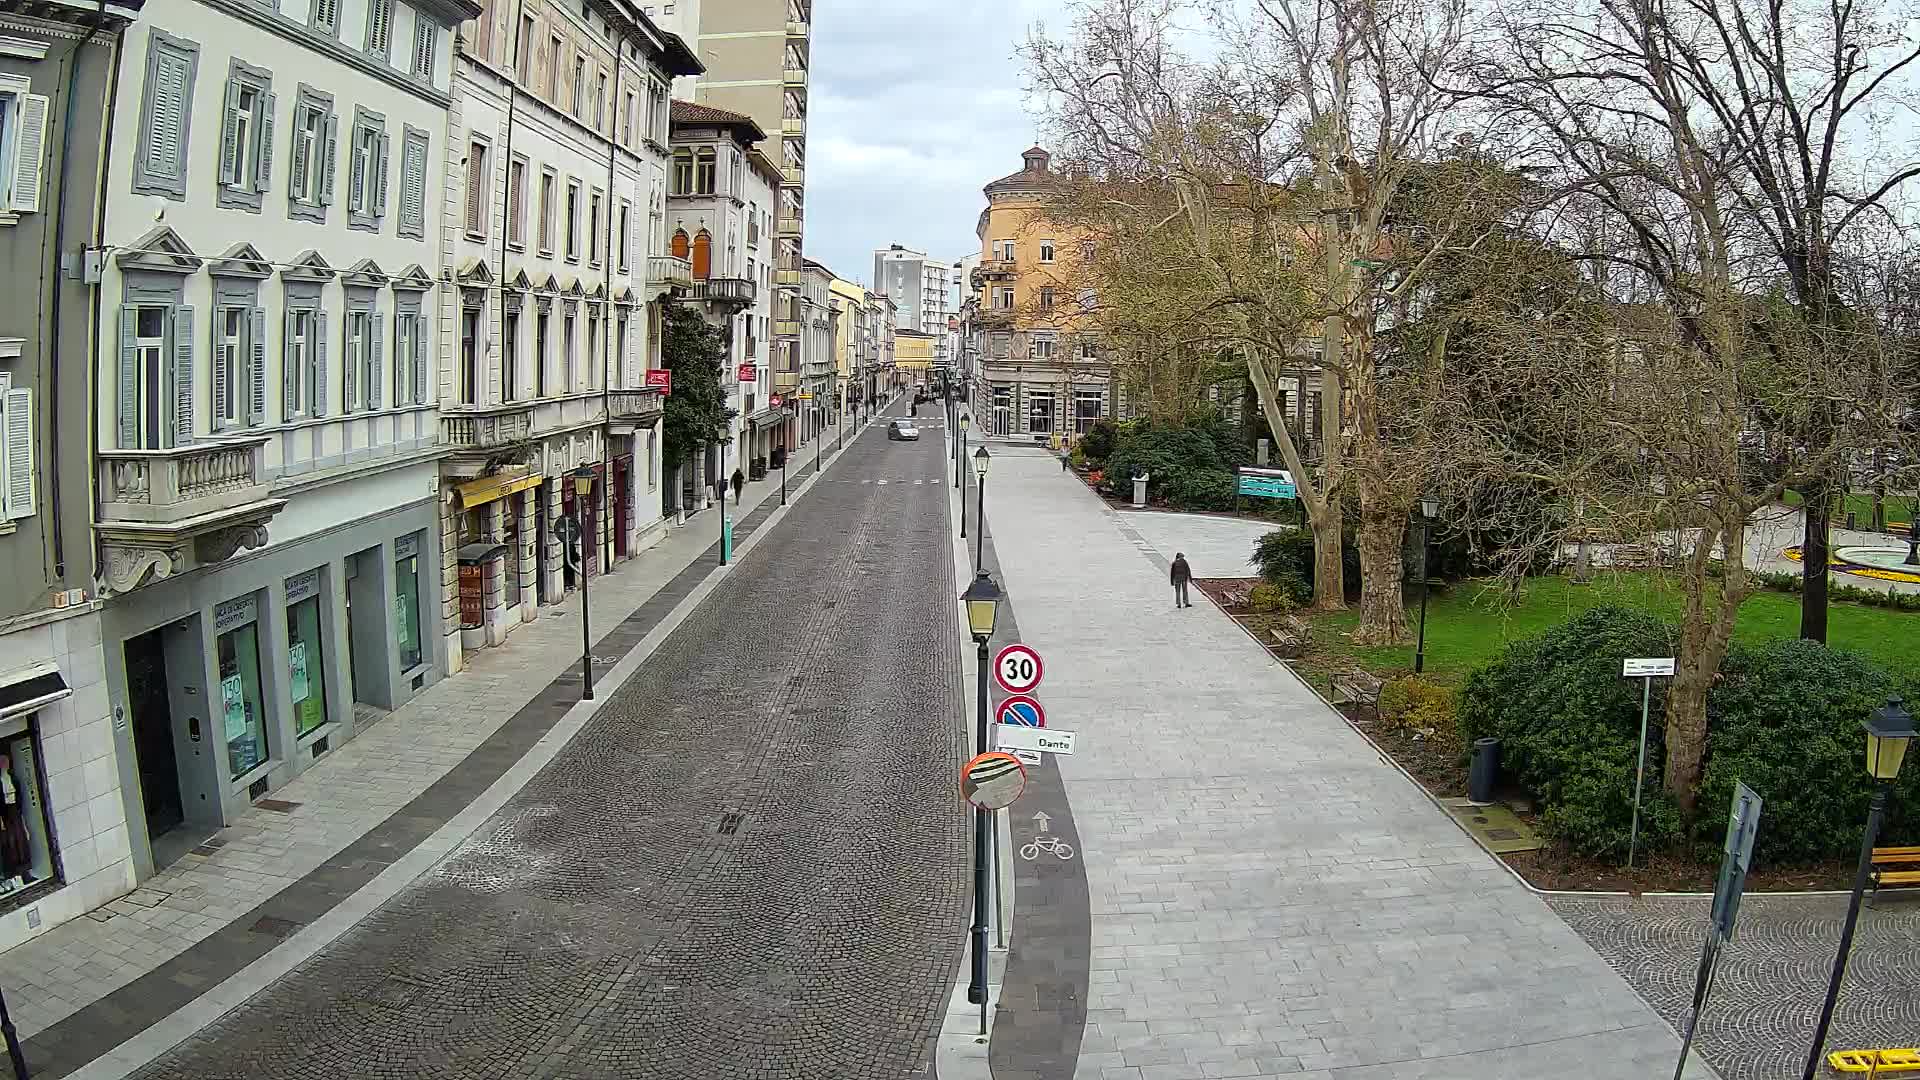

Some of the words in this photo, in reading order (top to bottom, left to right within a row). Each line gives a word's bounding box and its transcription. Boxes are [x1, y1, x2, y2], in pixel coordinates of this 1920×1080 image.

[1006, 658, 1033, 680] 30
[223, 677, 241, 701] 130
[1039, 739, 1070, 749] Dante
